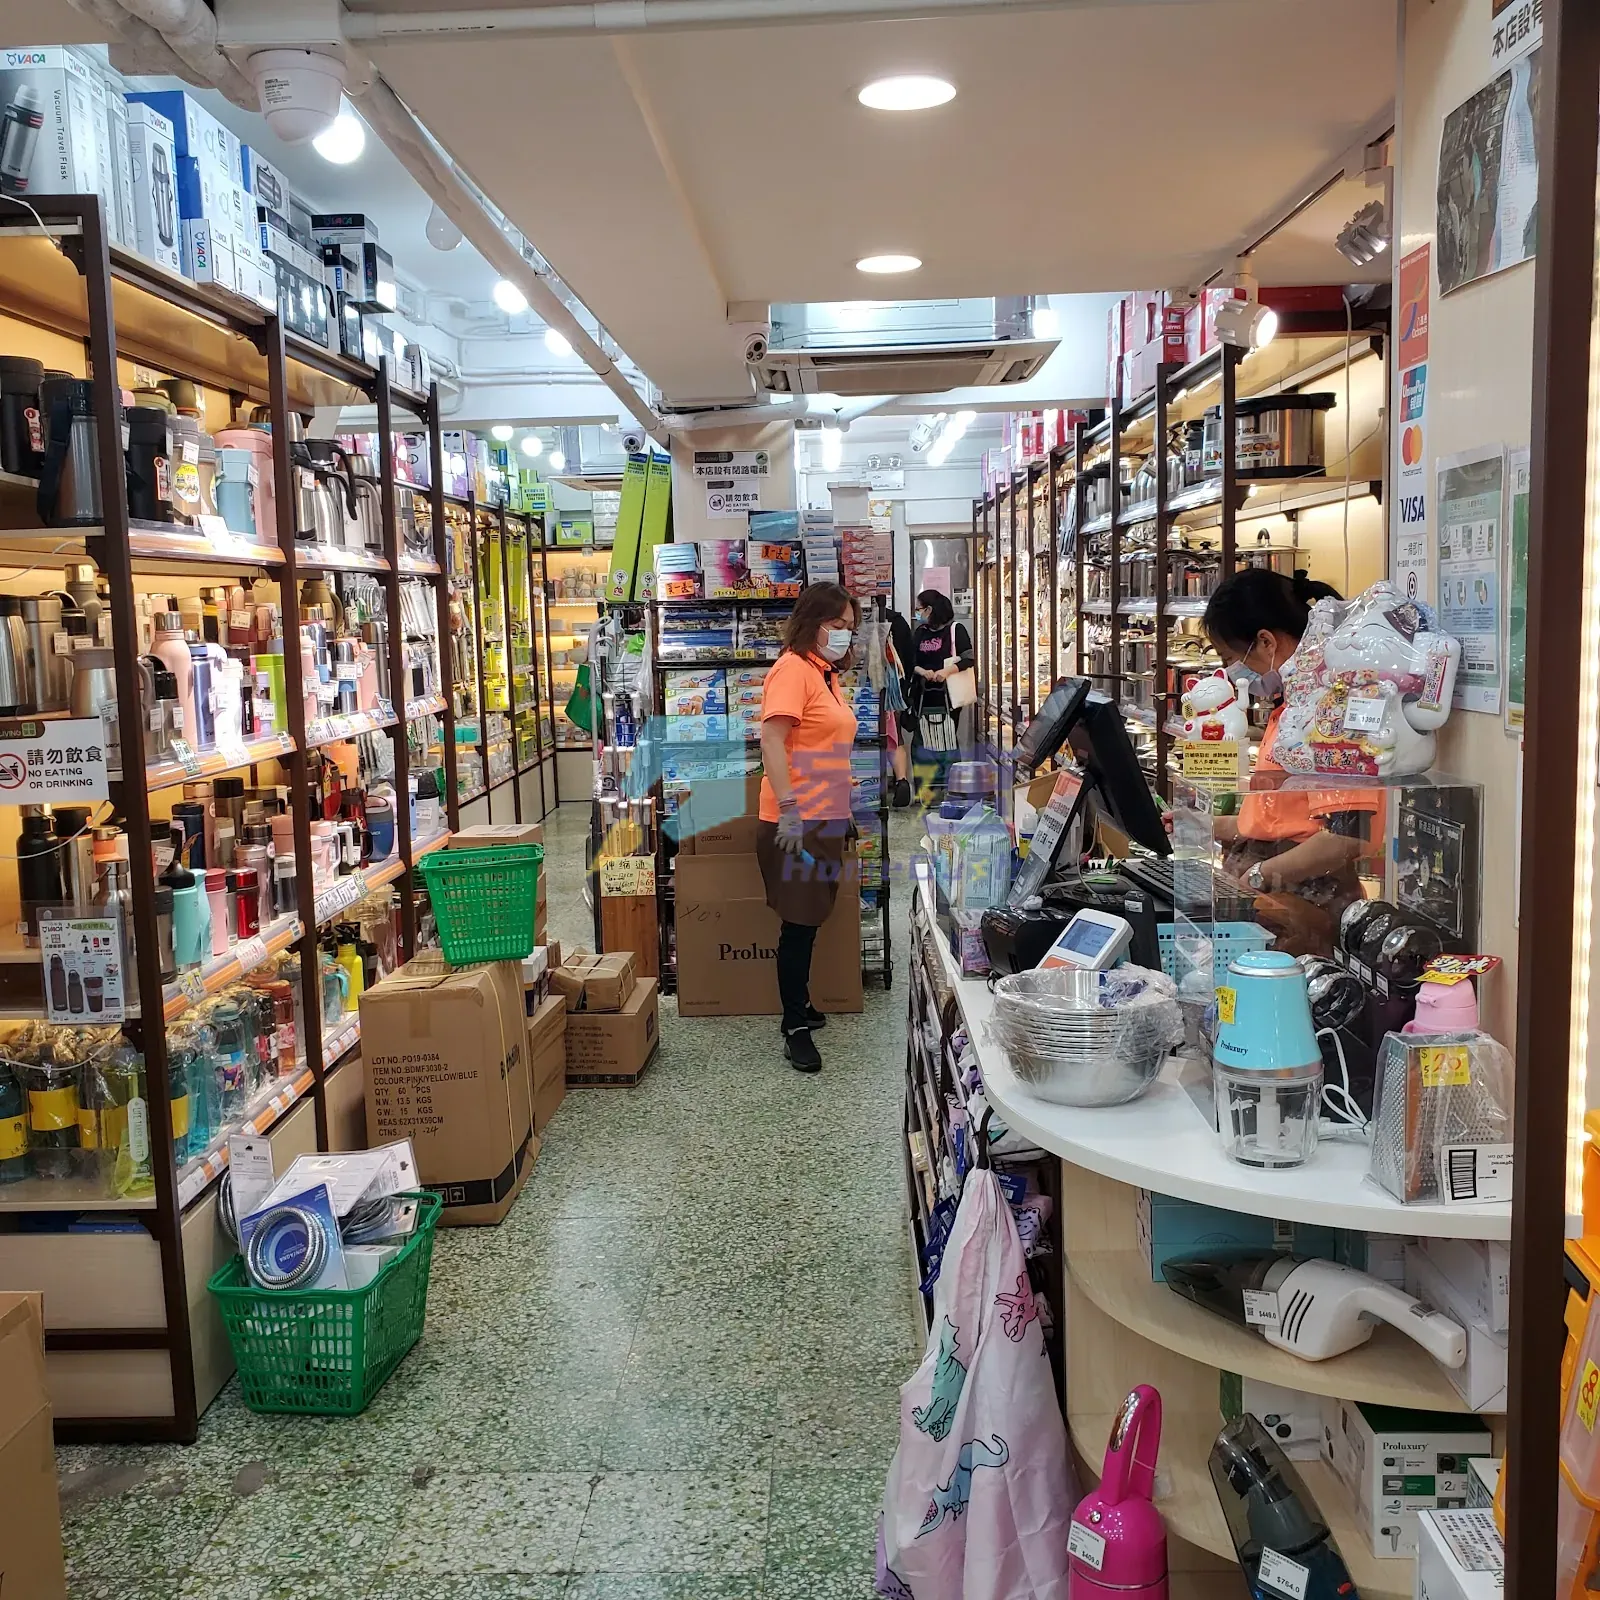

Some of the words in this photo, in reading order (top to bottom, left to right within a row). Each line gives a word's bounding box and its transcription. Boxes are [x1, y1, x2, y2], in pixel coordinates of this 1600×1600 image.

[17, 53, 46, 65] VACA
[53, 89, 63, 124] Vacuum
[57, 126, 65, 154] Travel
[60, 156, 68, 180] Flask
[197, 241, 206, 268] VACA
[696, 465, 768, 476] 本店設有閉路電視
[725, 493, 759, 502] 請勿飲食
[1400, 495, 1425, 523] VISA
[27, 745, 103, 766] 請勿飲食
[28, 770, 42, 778] NO
[45, 768, 83, 777] EATING
[46, 779, 93, 788] DRINKING
[1221, 1040, 1248, 1056] Proluxury
[372, 1057, 385, 1065] LOT
[373, 1067, 389, 1075] ITEM
[416, 1086, 431, 1094] PCS
[1259, 1310, 1277, 1319] $449.0
[1382, 1441, 1427, 1453] Proluxury
[1082, 1551, 1100, 1566] $409.0
[1276, 1576, 1300, 1593] $764.0
